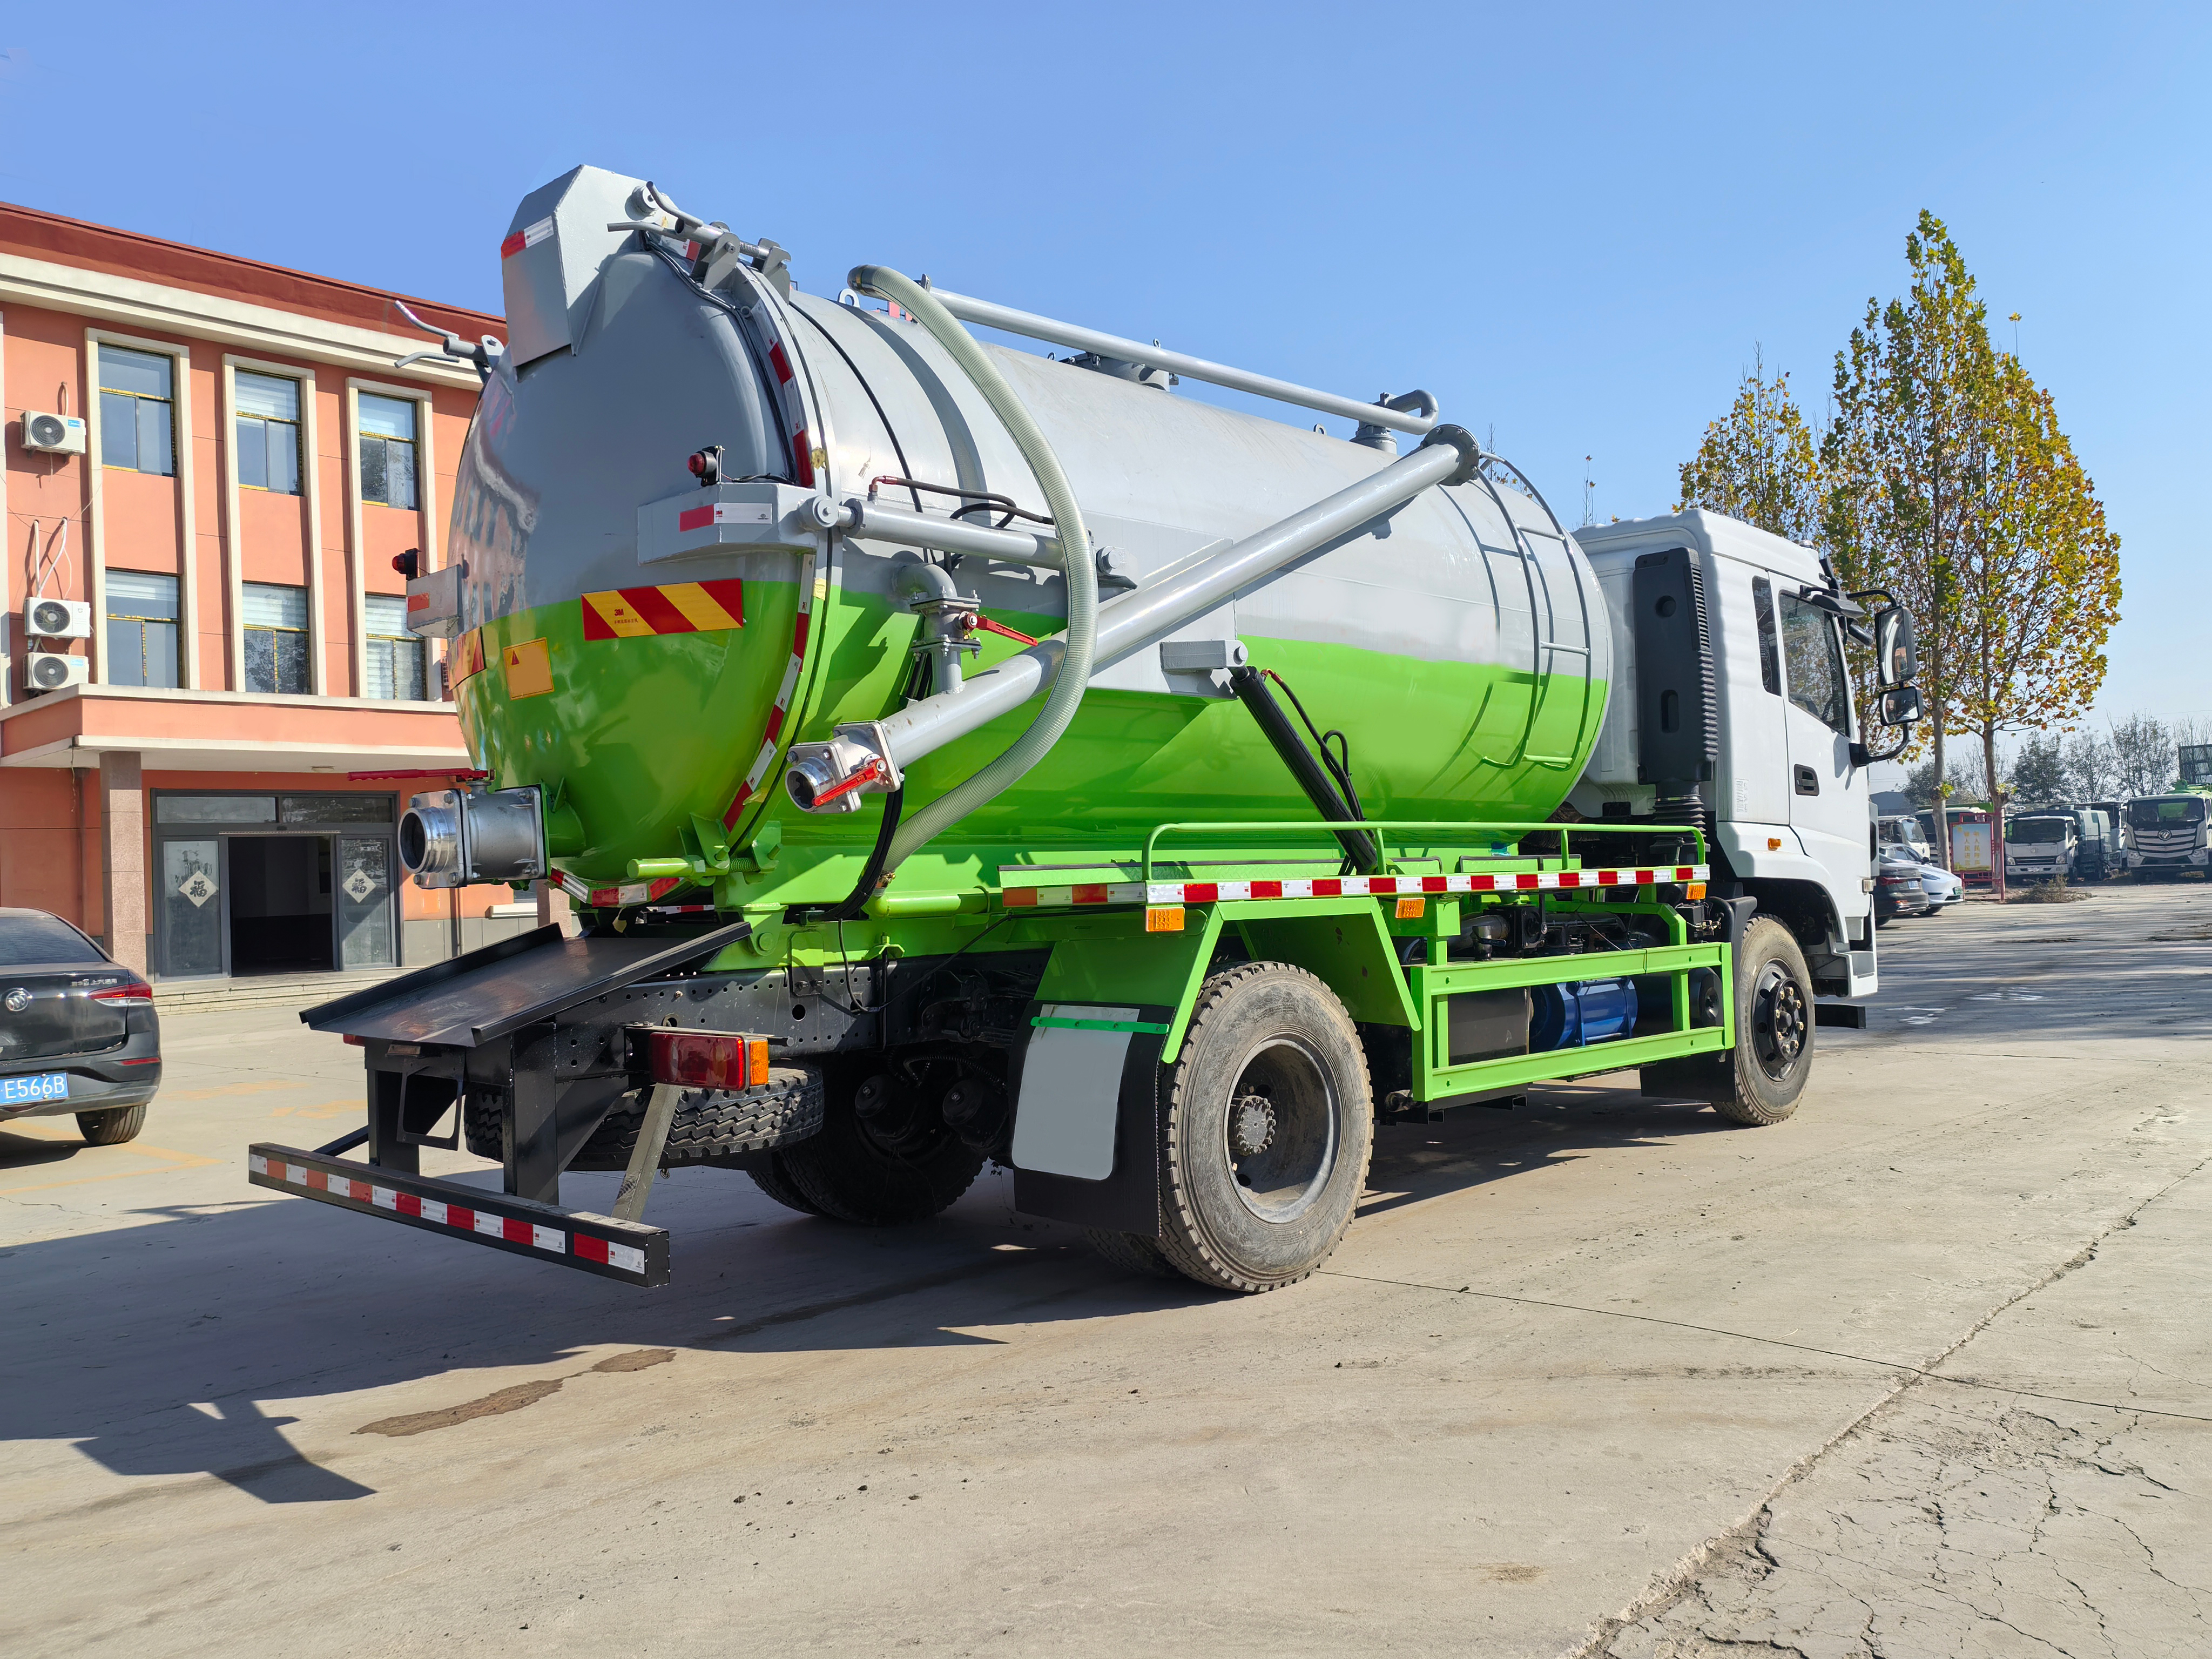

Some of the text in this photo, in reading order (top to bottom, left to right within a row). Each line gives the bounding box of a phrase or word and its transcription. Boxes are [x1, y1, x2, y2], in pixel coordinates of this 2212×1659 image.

[614, 608, 624, 616] 3M
[190, 880, 207, 898] 福
[352, 878, 367, 894] 福
[4, 1076, 65, 1099] E566B
